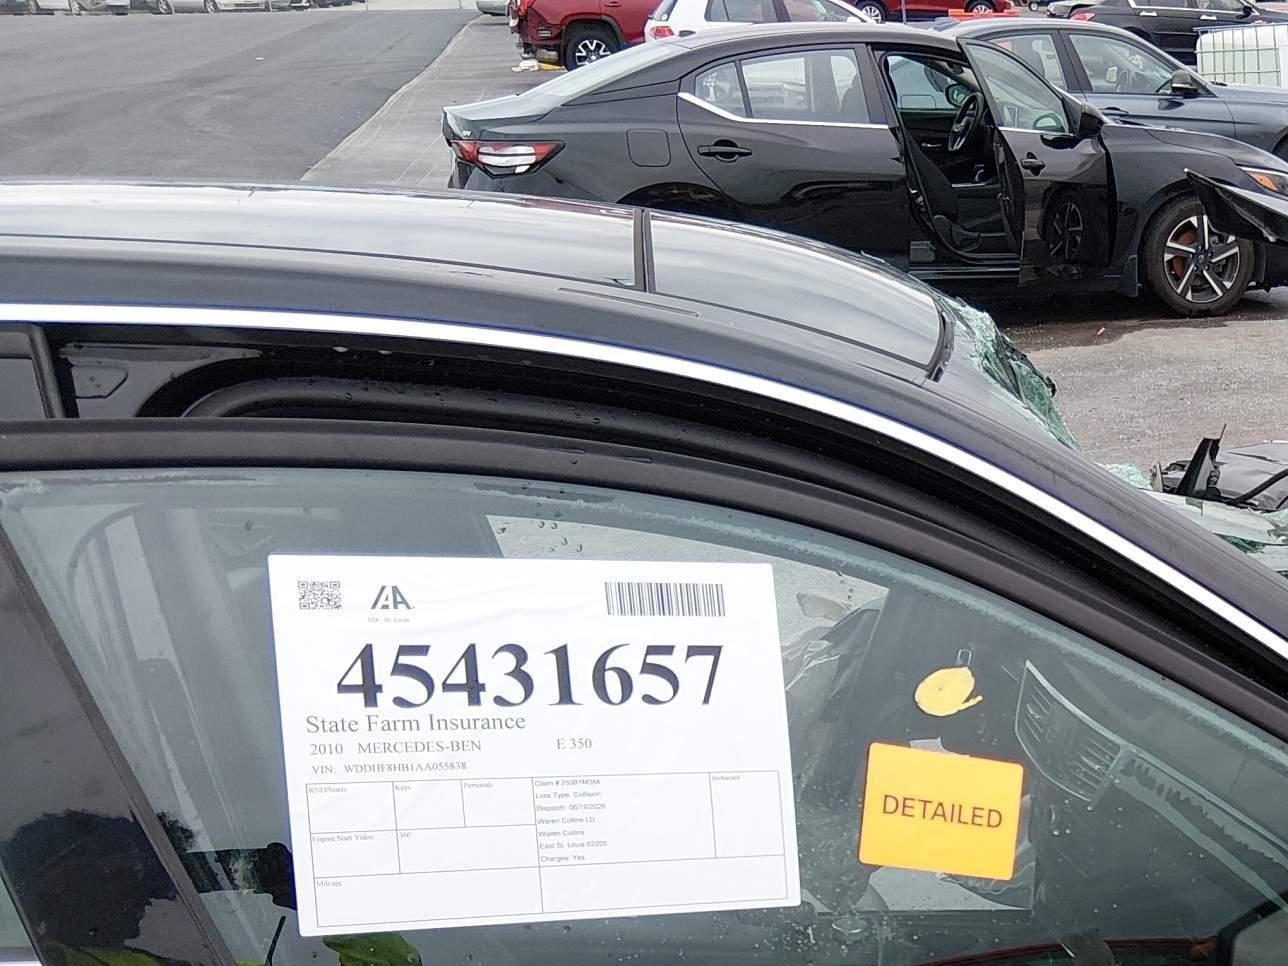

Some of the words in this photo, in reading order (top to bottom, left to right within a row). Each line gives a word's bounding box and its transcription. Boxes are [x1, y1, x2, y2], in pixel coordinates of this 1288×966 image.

[337, 643, 723, 708] 45431657
[306, 716, 358, 733] State
[367, 715, 420, 731] Farm
[429, 714, 525, 730] Insurance
[311, 744, 343, 755] 2010
[358, 740, 481, 753] MERCEDES-BEN
[557, 738, 567, 750] E
[570, 738, 592, 749] 350
[311, 764, 337, 775] VIN:
[883, 795, 1002, 828] DETAILED
